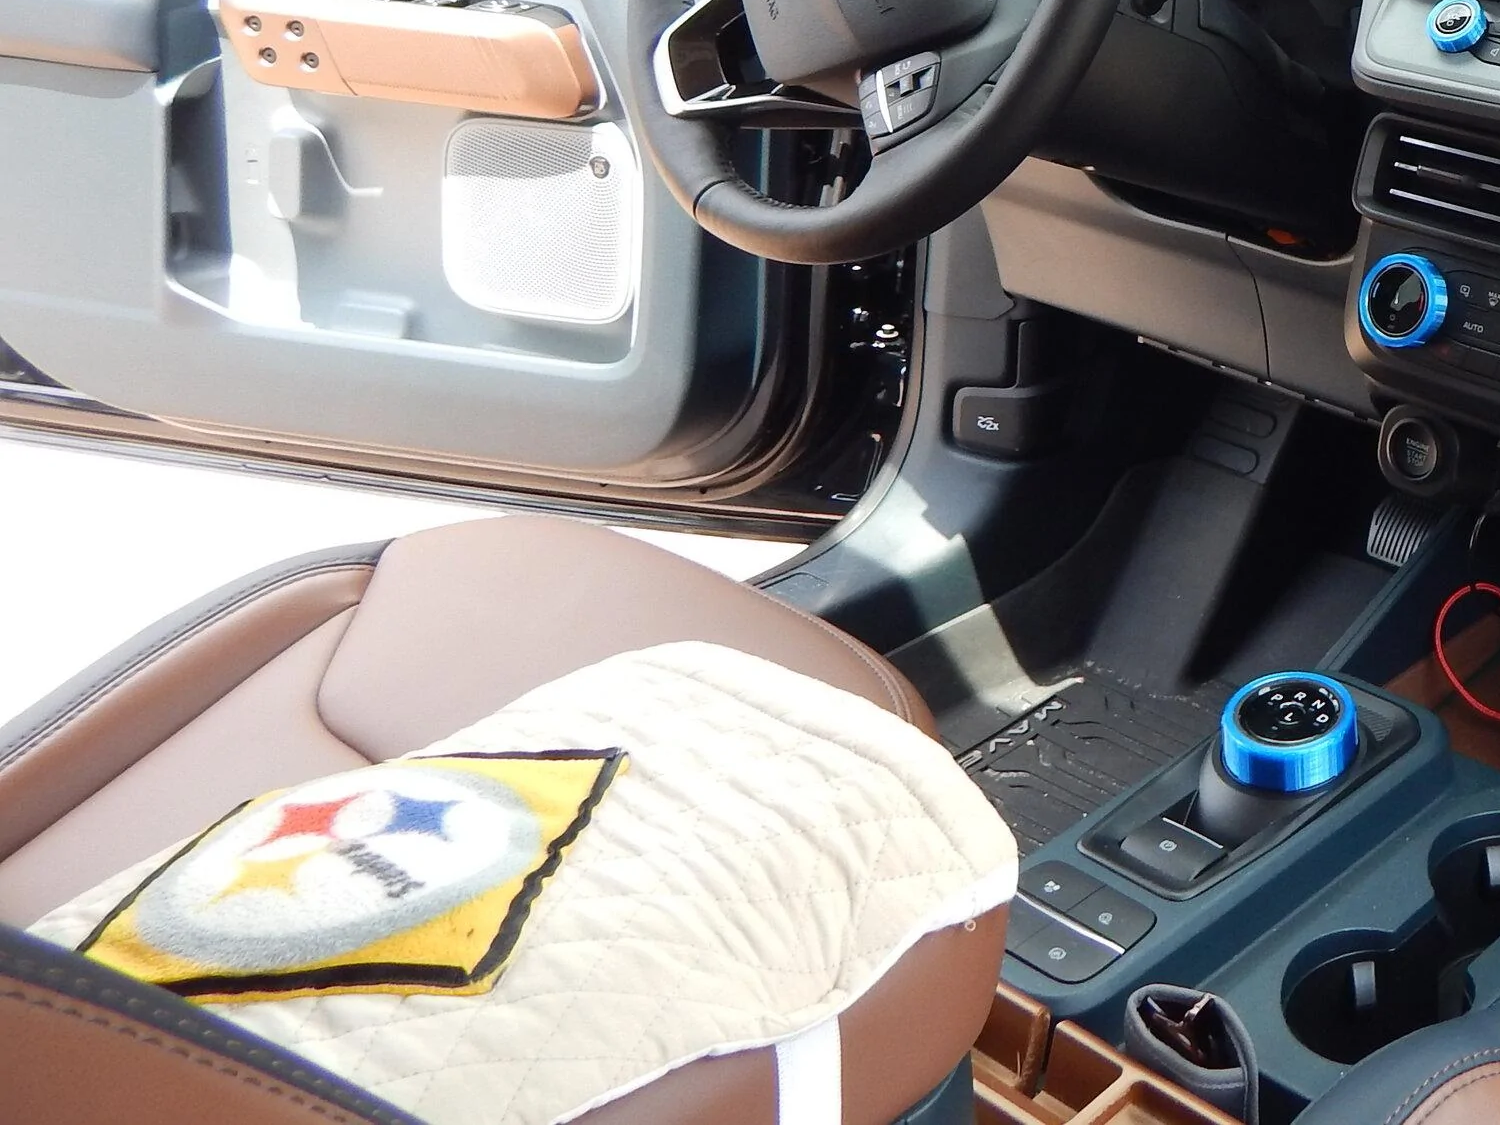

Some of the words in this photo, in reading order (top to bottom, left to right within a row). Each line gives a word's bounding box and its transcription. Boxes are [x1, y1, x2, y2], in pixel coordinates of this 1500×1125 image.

[1463, 321, 1484, 333] AUTO
[1406, 437, 1429, 452] ENGINE
[1270, 693, 1284, 702] P
[1294, 691, 1307, 701] R
[1311, 699, 1326, 710] N
[1284, 712, 1294, 721] L
[1315, 713, 1329, 723] D
